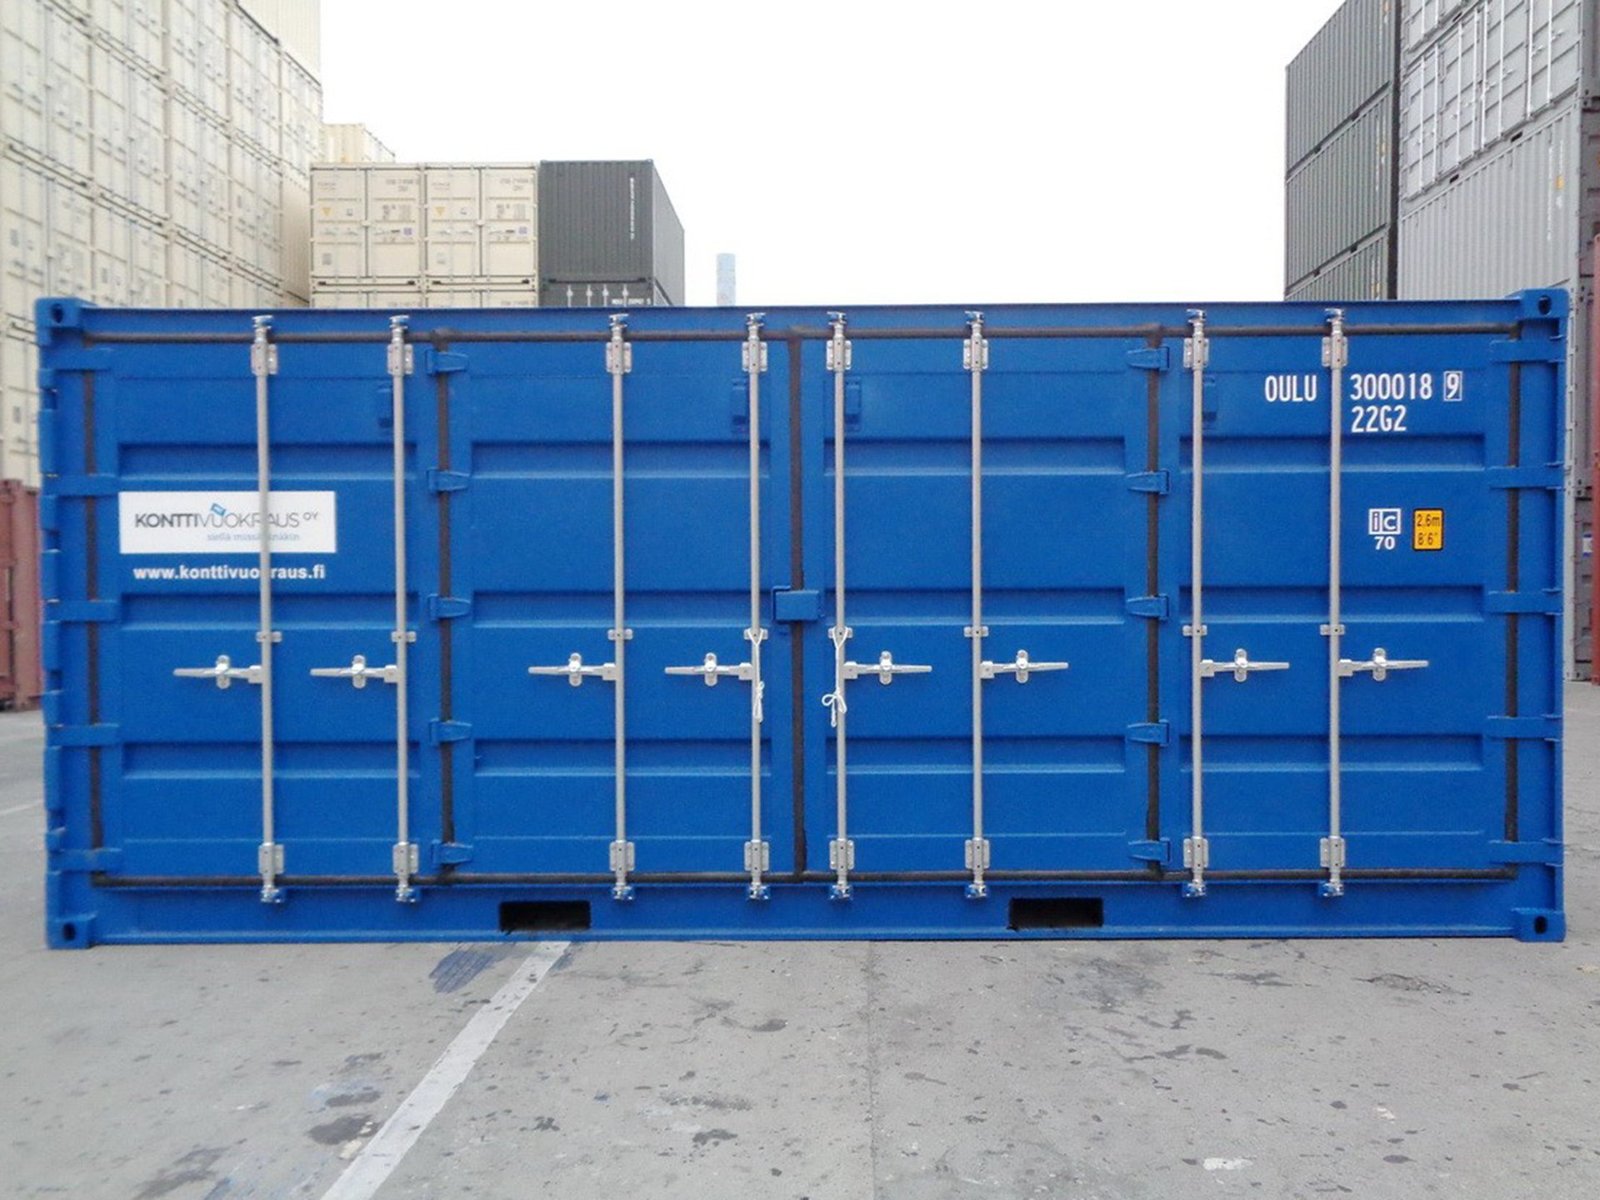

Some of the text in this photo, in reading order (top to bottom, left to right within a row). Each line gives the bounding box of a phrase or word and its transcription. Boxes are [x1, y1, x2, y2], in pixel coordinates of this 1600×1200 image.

[1264, 373, 1460, 402] OULU 300018 9
[1351, 405, 1407, 433] 22G2
[1374, 536, 1396, 550] 70
[133, 564, 326, 580] www.konttivuoraus.fi
